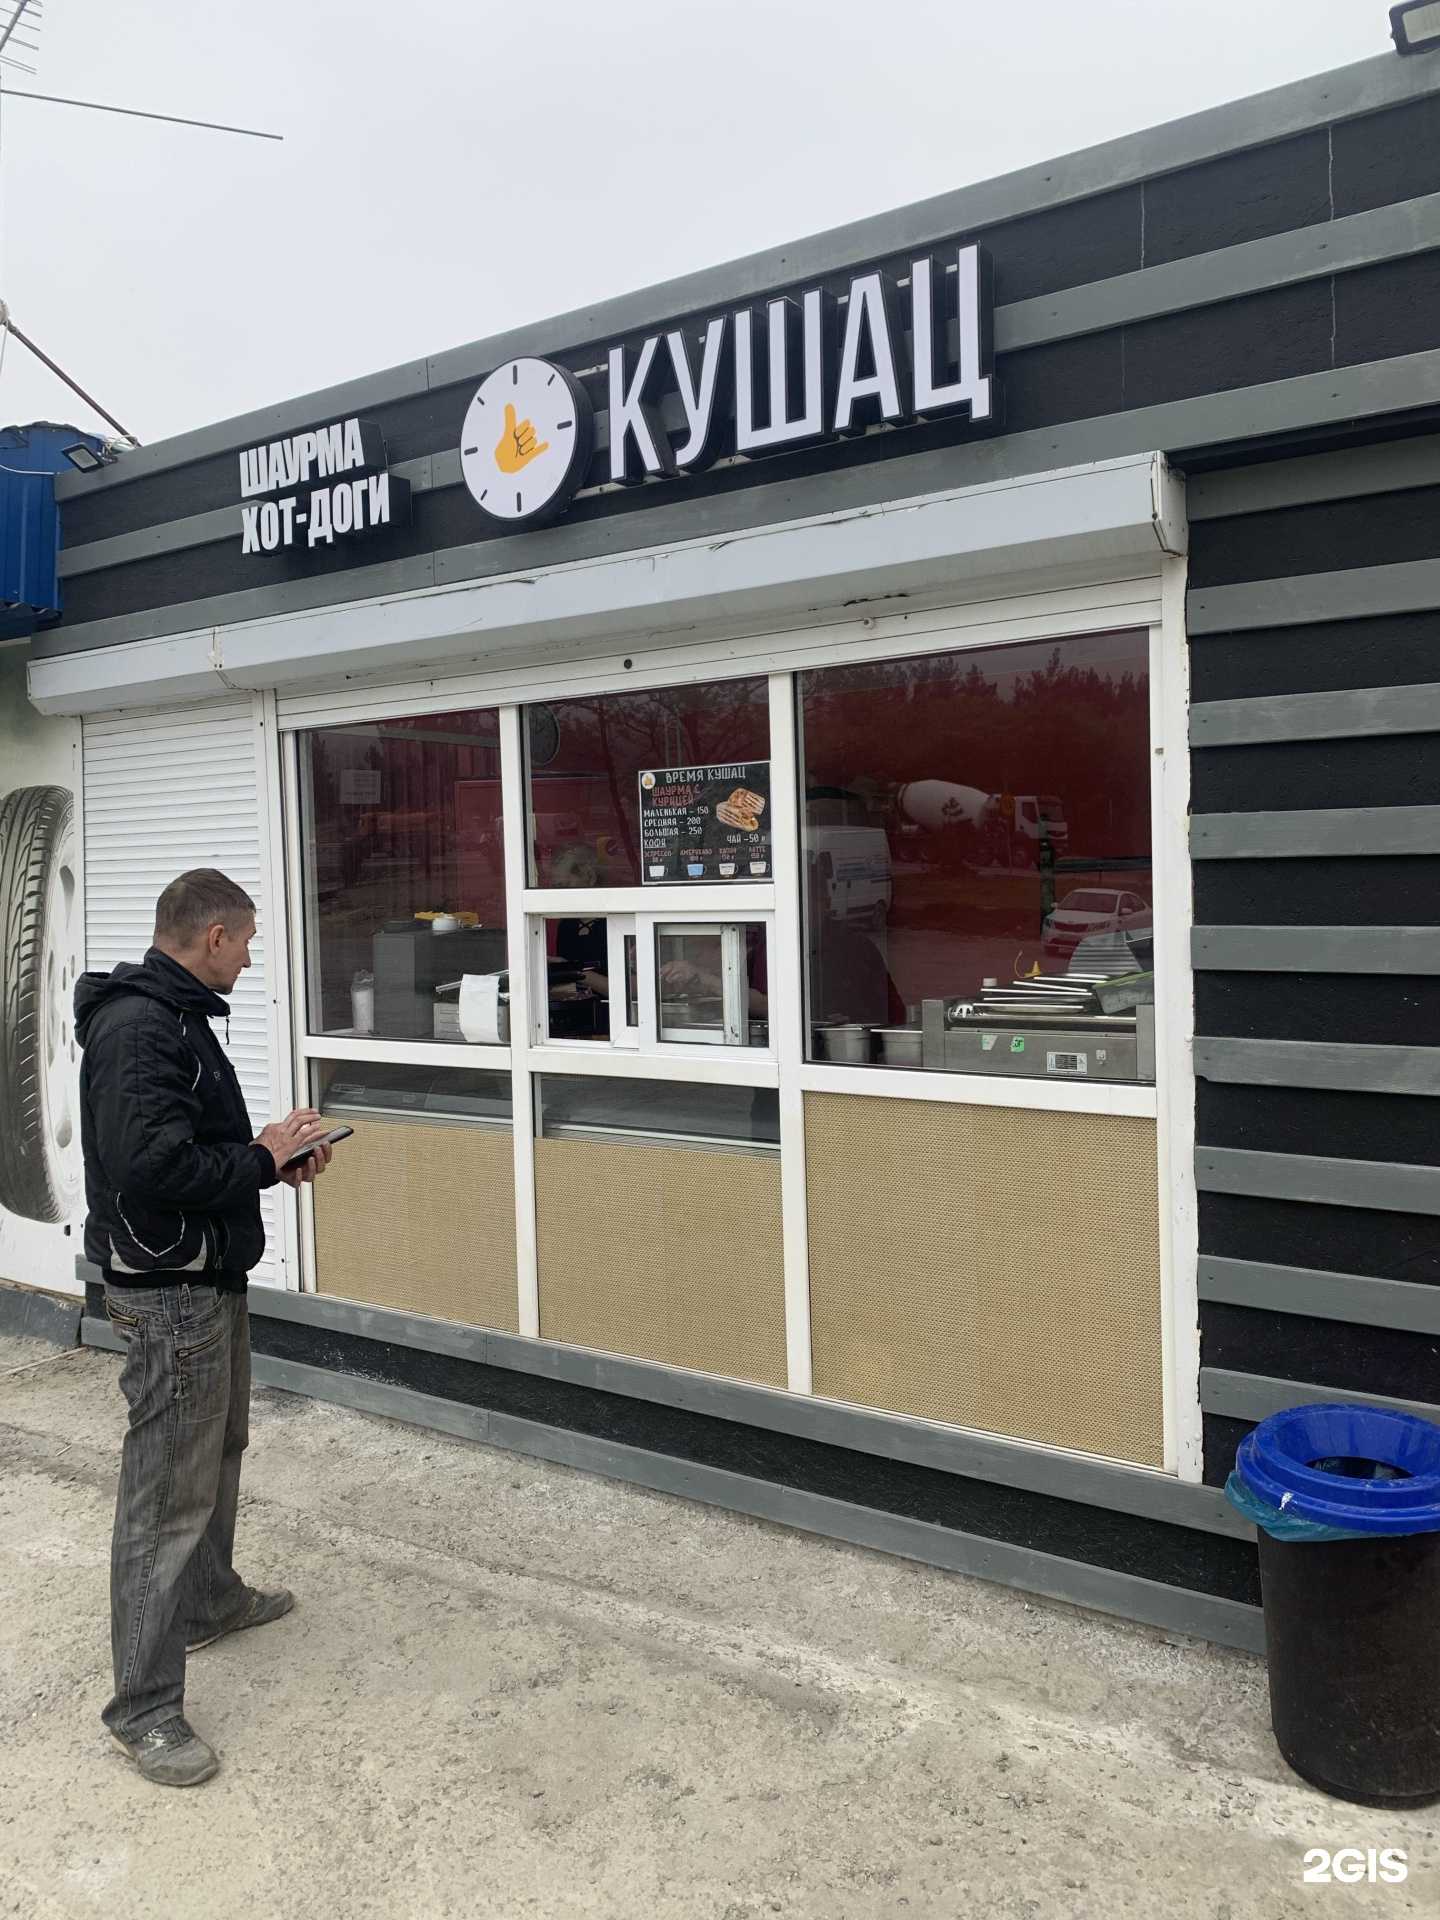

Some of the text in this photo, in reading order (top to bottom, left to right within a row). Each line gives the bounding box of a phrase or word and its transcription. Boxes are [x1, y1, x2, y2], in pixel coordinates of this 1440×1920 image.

[607, 244, 993, 482] КУШАЦ
[239, 418, 366, 498] ШАУРМА
[241, 473, 390, 554] ХОТ-ДОГИ
[665, 766, 746, 784] ВРЕМЯ КУШАЦ
[652, 785, 692, 797] ШАУРМА
[643, 807, 687, 817] МАЛЕНЬКАЯ
[697, 806, 709, 815] 150
[644, 818, 677, 827] СРЕДНЯЯ
[686, 816, 701, 825] 200
[644, 827, 679, 837] БОЛЬШАЯ
[688, 826, 703, 835] 250
[726, 834, 741, 844] ЧАЙ
